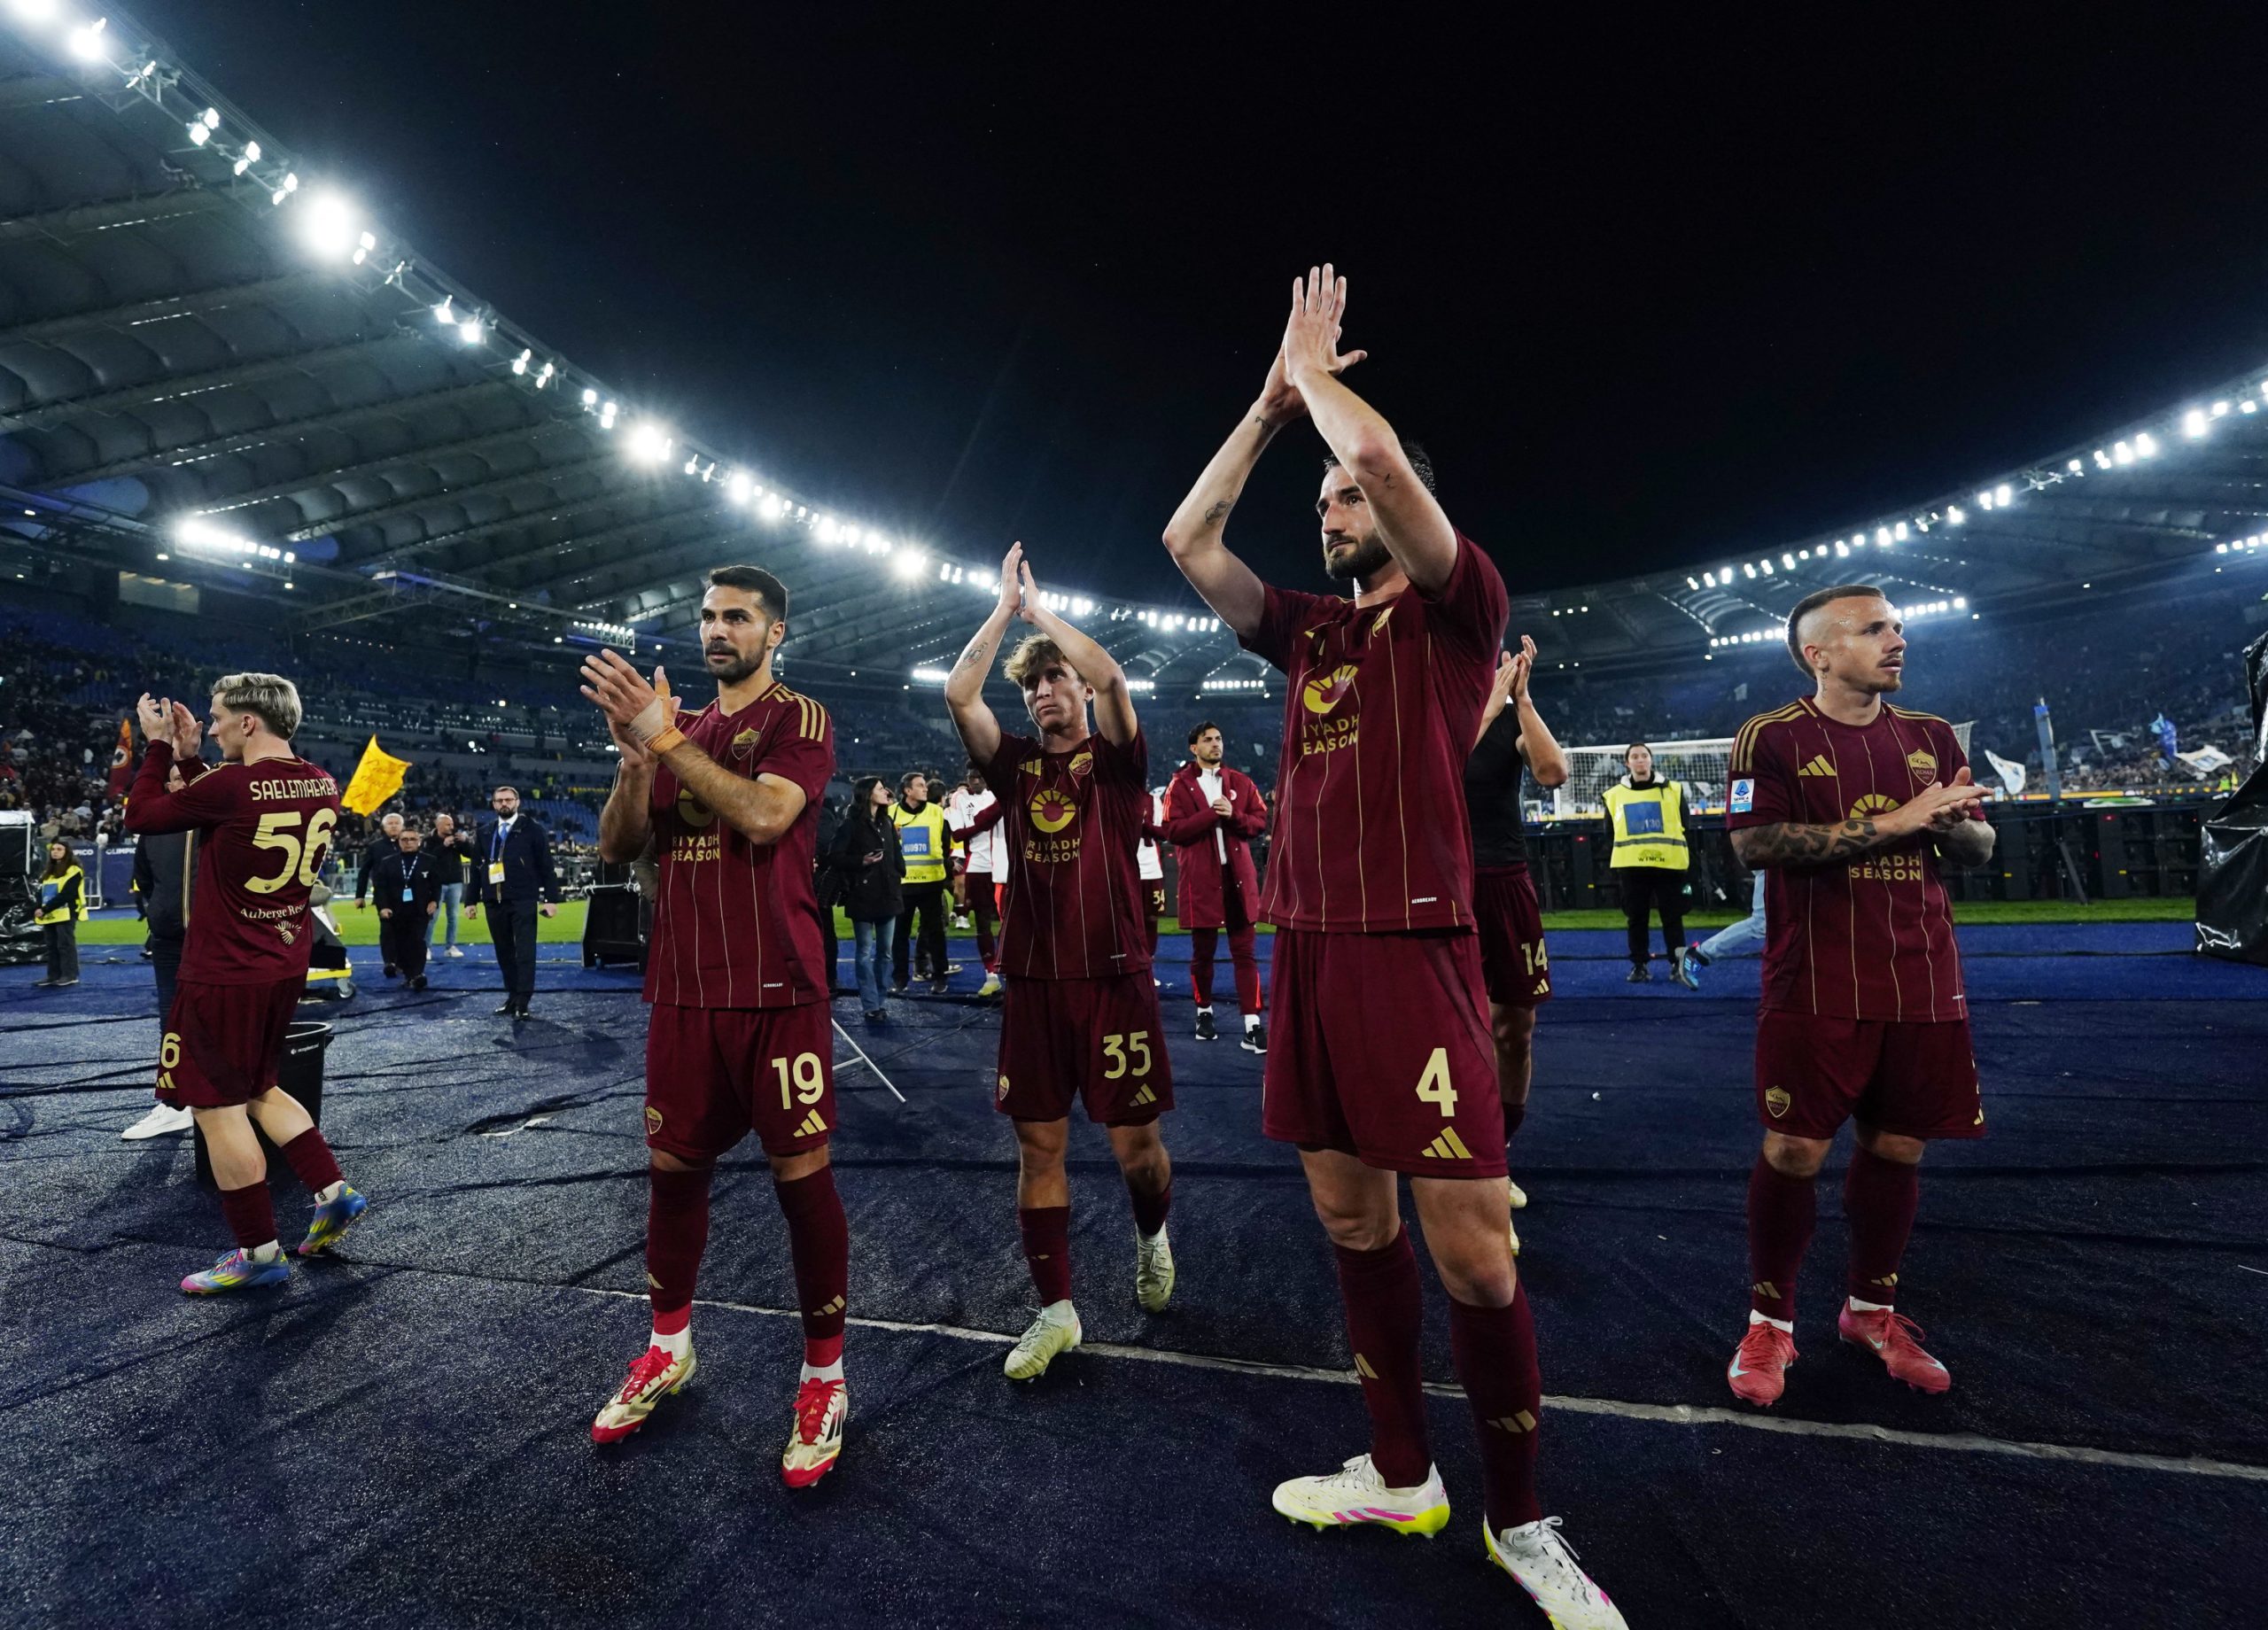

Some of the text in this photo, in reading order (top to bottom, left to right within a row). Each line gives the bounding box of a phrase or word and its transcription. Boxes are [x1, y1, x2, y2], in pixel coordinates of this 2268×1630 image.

[1303, 714, 1360, 738] IYADH
[1303, 730, 1358, 756] EASON
[244, 808, 337, 894] 56
[672, 834, 719, 848] RIYADH
[1028, 838, 1080, 850] RIYADH
[672, 848, 720, 862] SEASON
[1026, 850, 1079, 863] SEASON
[1867, 854, 1921, 867] ADH
[1851, 866, 1922, 881] SEASON
[240, 907, 287, 920] Auberge
[1521, 938, 1548, 975] 14
[160, 1032, 181, 1068] 6
[1103, 1030, 1152, 1079] 35
[772, 1052, 824, 1110] 19
[1416, 1047, 1458, 1117] 4
